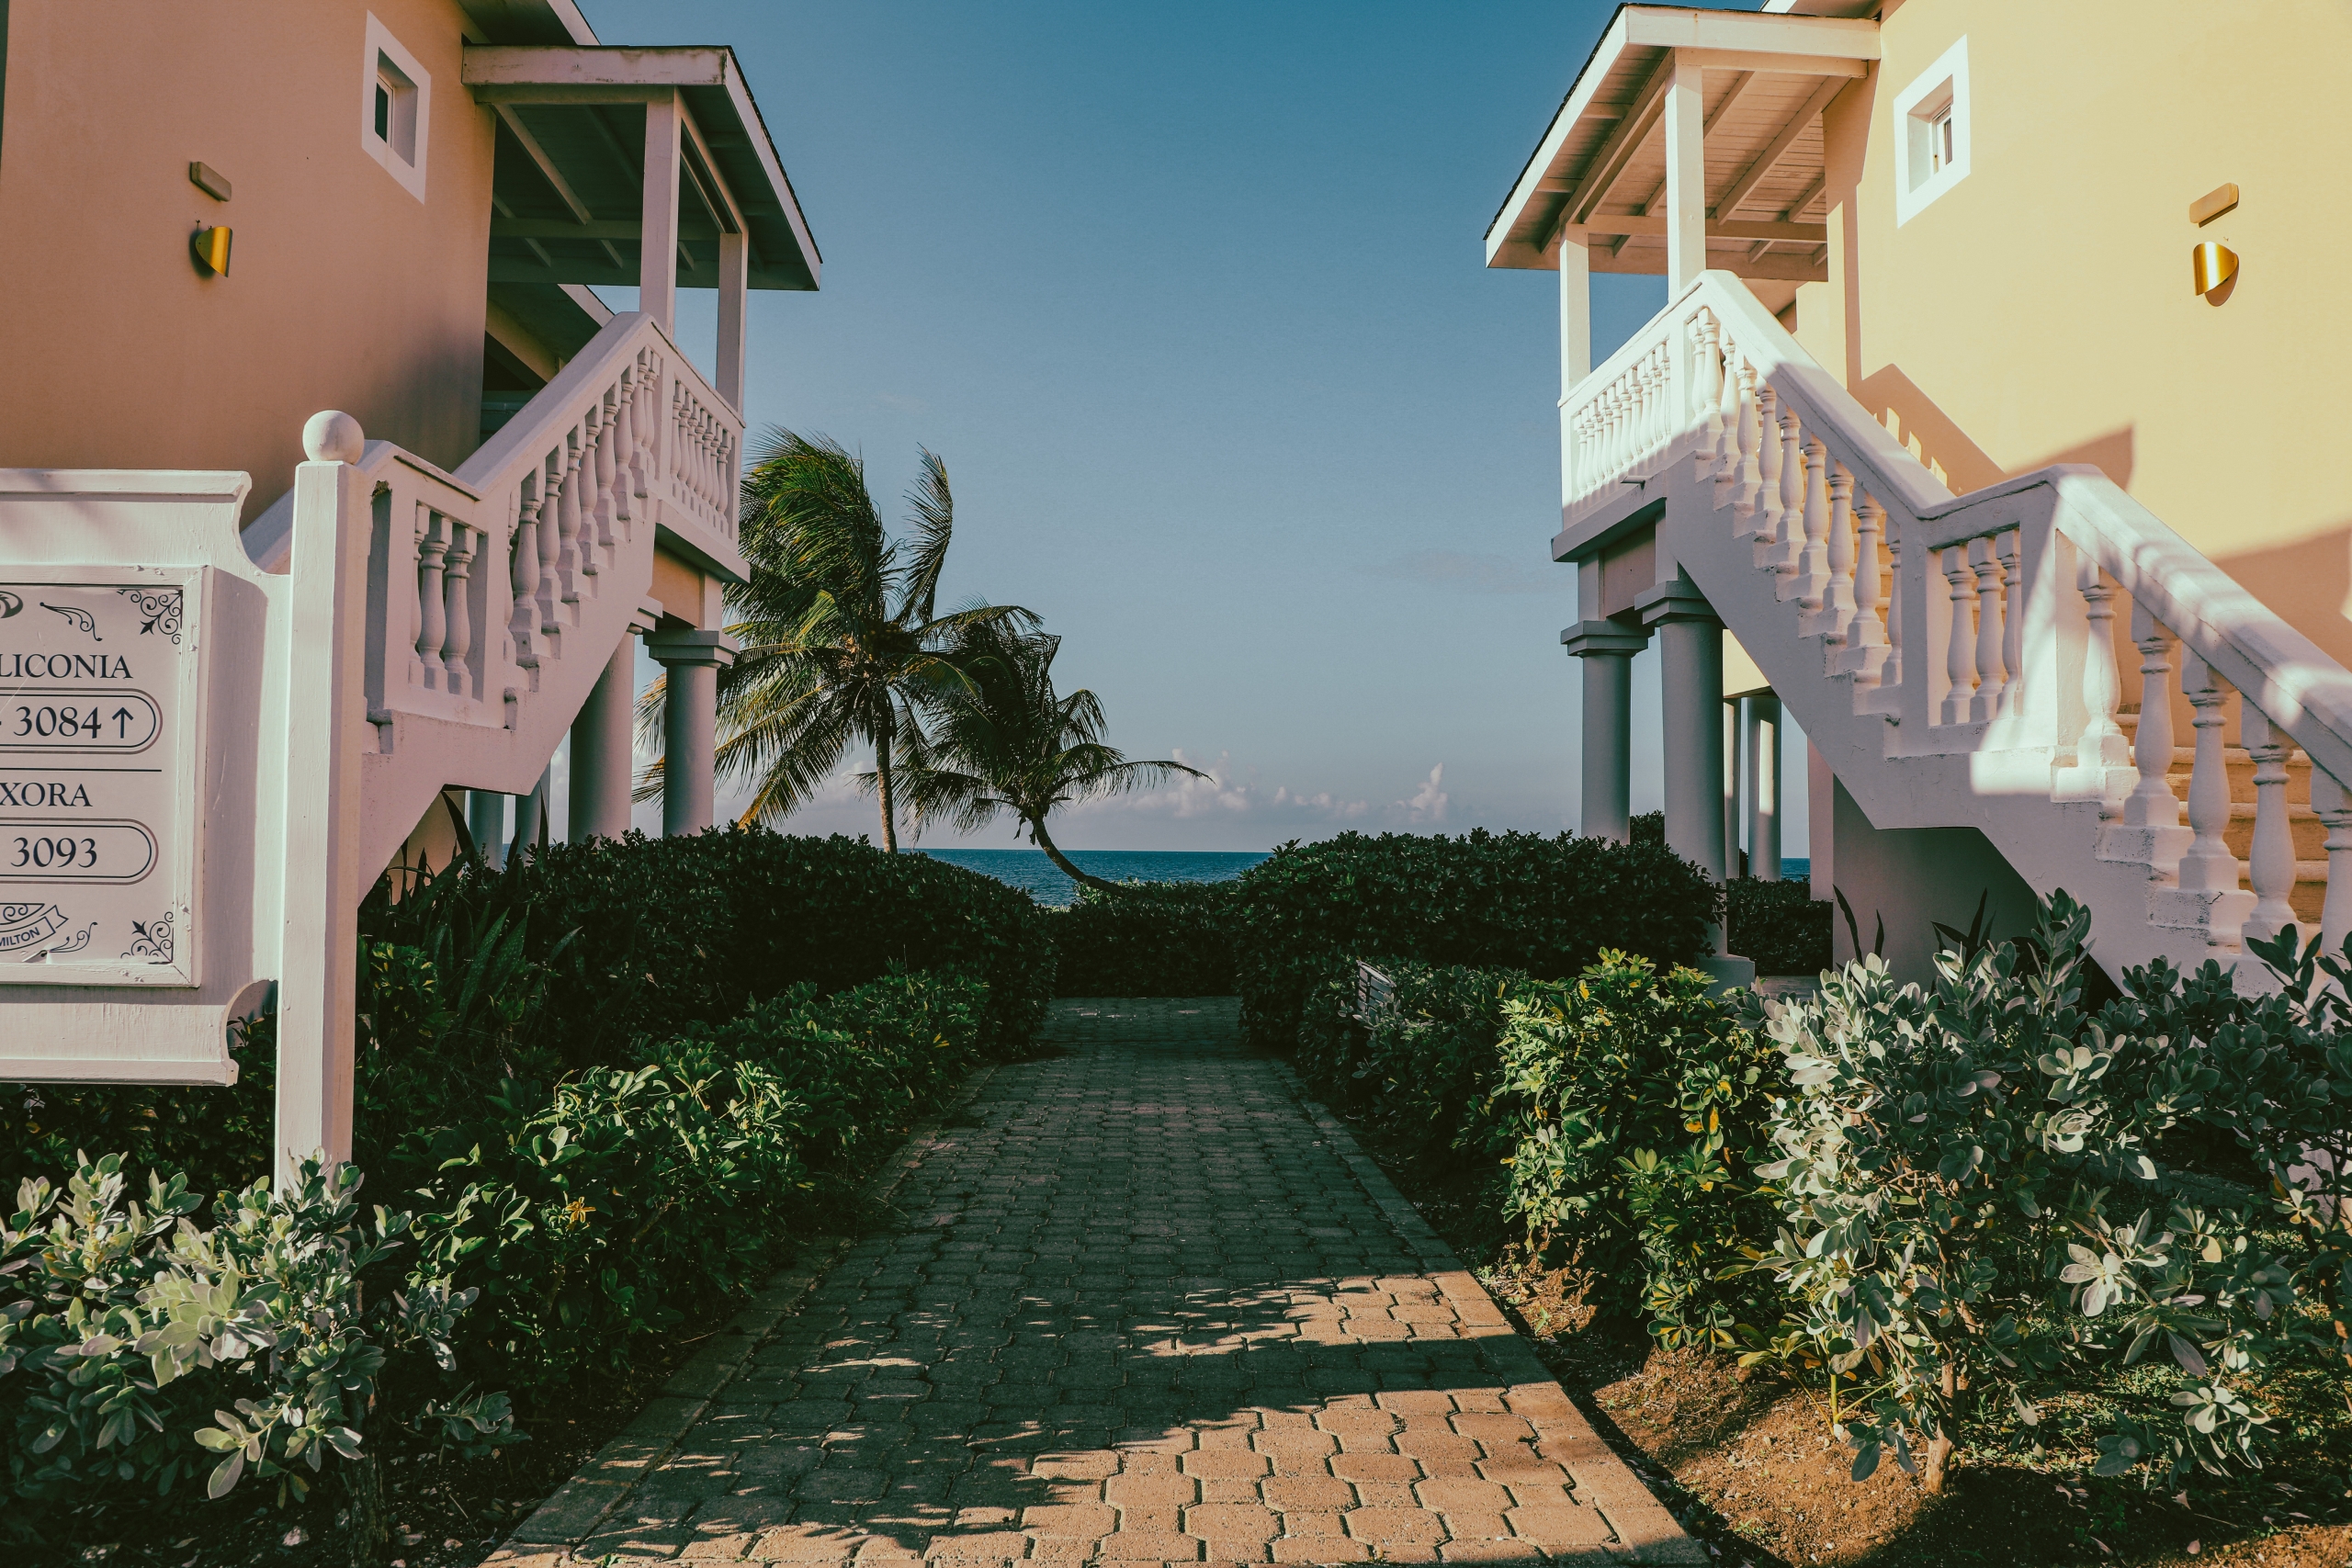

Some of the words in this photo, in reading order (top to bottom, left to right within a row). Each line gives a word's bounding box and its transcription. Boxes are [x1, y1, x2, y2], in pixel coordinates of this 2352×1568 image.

[13, 705, 102, 739] 3084
[0, 782, 93, 807] XORA
[10, 837, 97, 868] 3093
